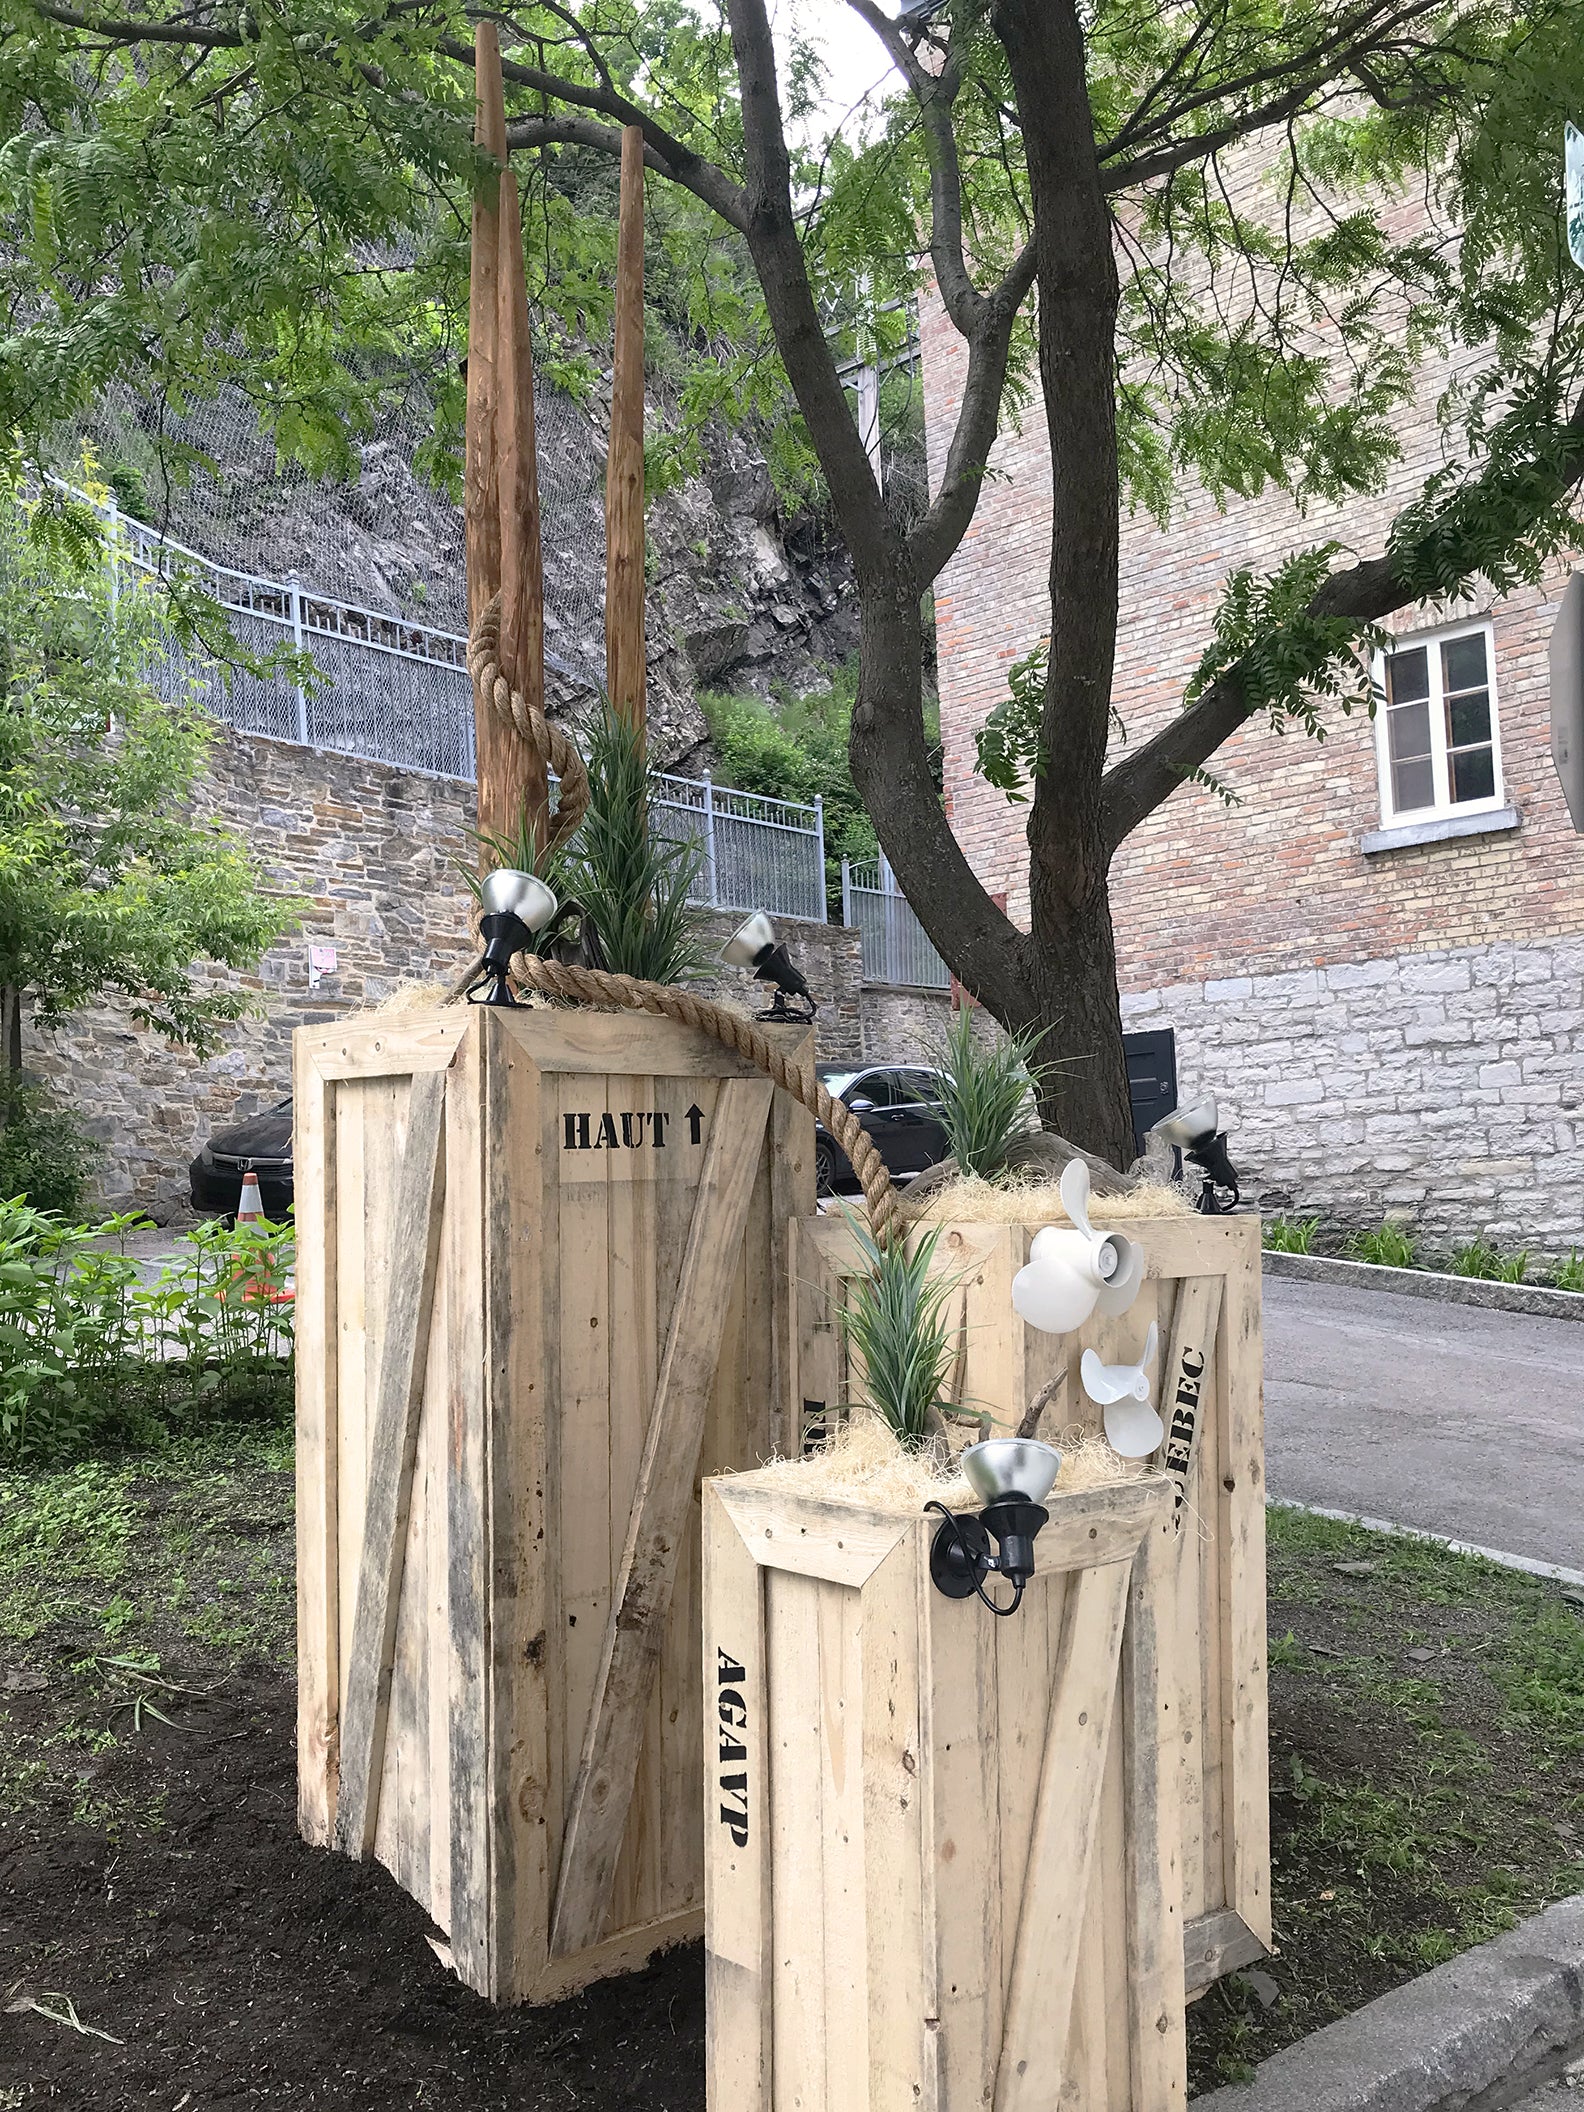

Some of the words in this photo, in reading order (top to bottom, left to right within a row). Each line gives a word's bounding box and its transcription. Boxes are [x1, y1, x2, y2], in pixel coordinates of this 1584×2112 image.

[563, 1112, 669, 1149] HAUT
[1165, 1346, 1205, 1536] EBEC
[718, 1646, 748, 1848] AGAVP
